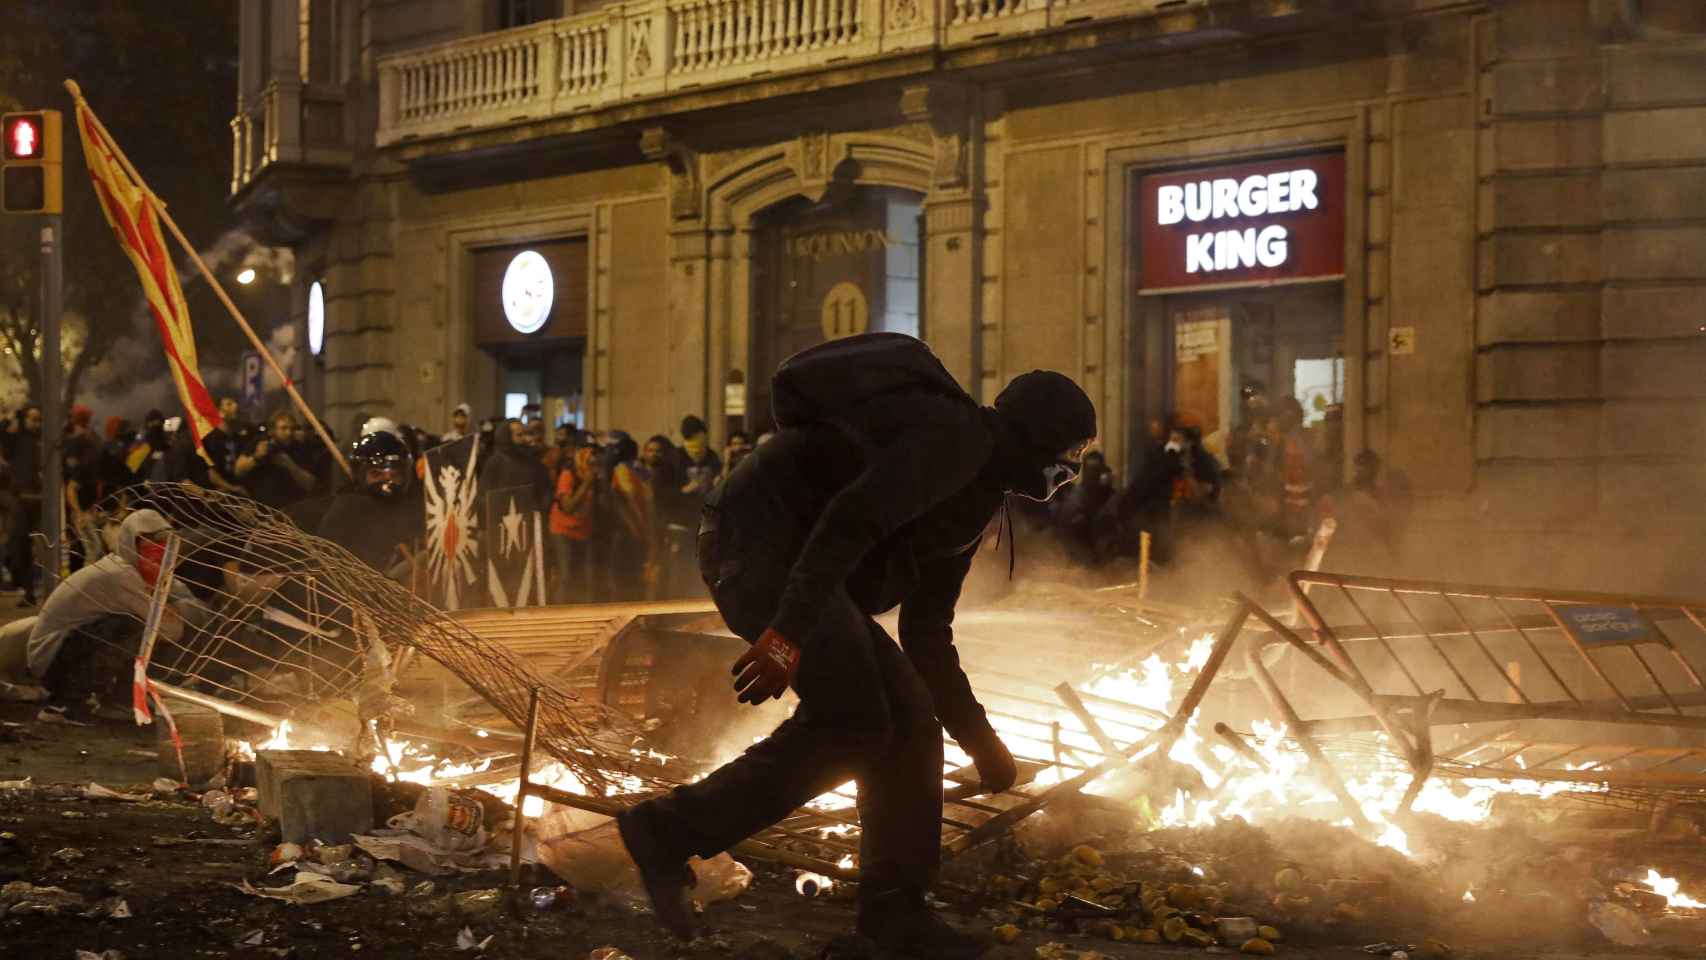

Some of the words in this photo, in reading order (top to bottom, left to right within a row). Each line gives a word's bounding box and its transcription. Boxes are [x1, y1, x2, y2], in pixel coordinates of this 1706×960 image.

[1158, 169, 1318, 225] BURGER
[1186, 225, 1288, 273] KING
[828, 297, 856, 334] 11
